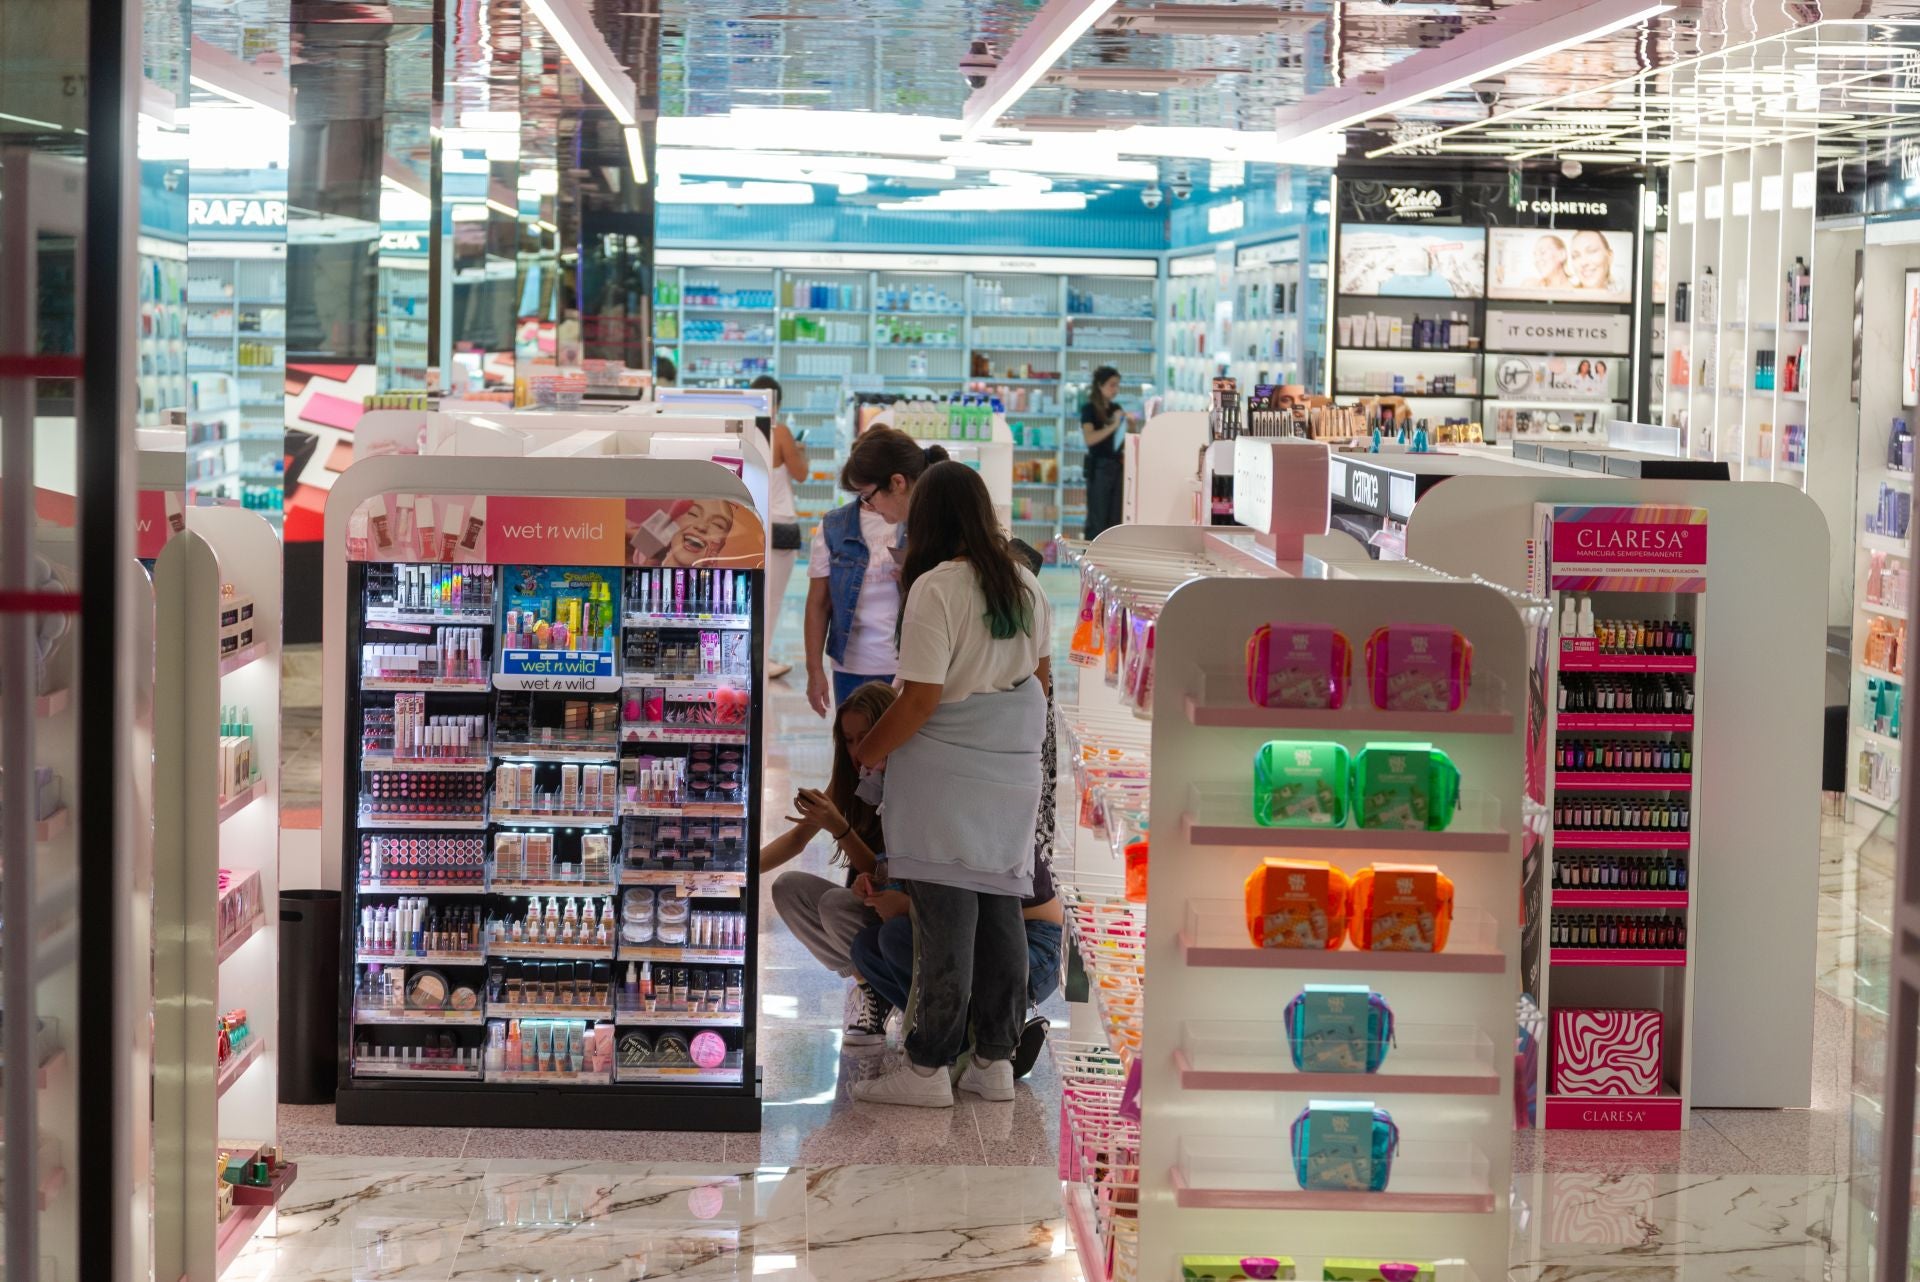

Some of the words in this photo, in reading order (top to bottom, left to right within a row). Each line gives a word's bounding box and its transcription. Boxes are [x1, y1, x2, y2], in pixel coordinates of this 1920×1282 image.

[188, 200, 287, 225] RAFAR
[1531, 200, 1608, 215] COSMETICS
[1525, 326, 1608, 339] COSMETICS
[502, 522, 543, 539] wet
[547, 525, 560, 540] n
[562, 522, 604, 540] wild
[521, 660, 551, 673] wet
[554, 661, 563, 673] n
[565, 660, 596, 673] wild
[520, 678, 550, 690] wet
[553, 680, 562, 690] n
[565, 678, 595, 690] wild
